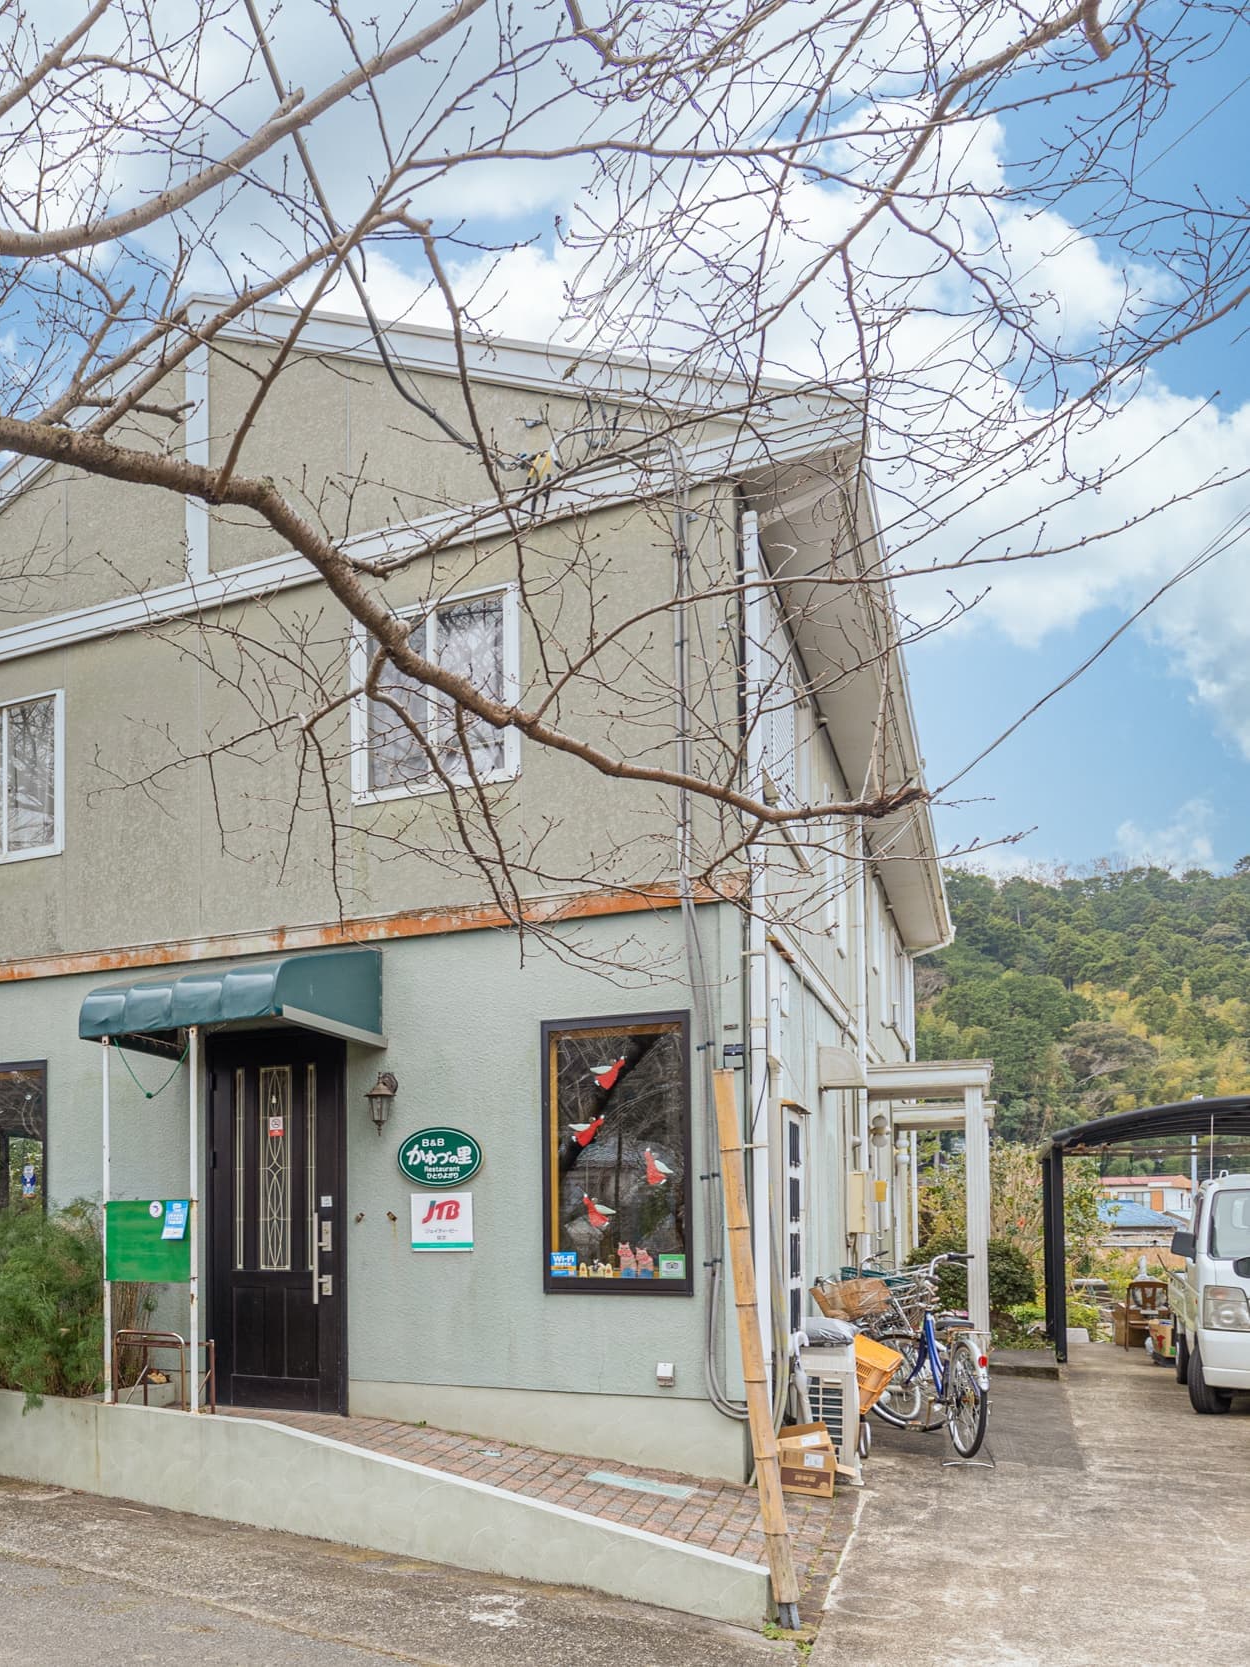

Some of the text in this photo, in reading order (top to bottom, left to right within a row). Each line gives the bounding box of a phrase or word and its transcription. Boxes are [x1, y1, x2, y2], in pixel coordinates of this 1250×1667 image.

[422, 1138, 445, 1147] B&B
[406, 1144, 472, 1165] かわづの里
[422, 1200, 460, 1224] JTB
